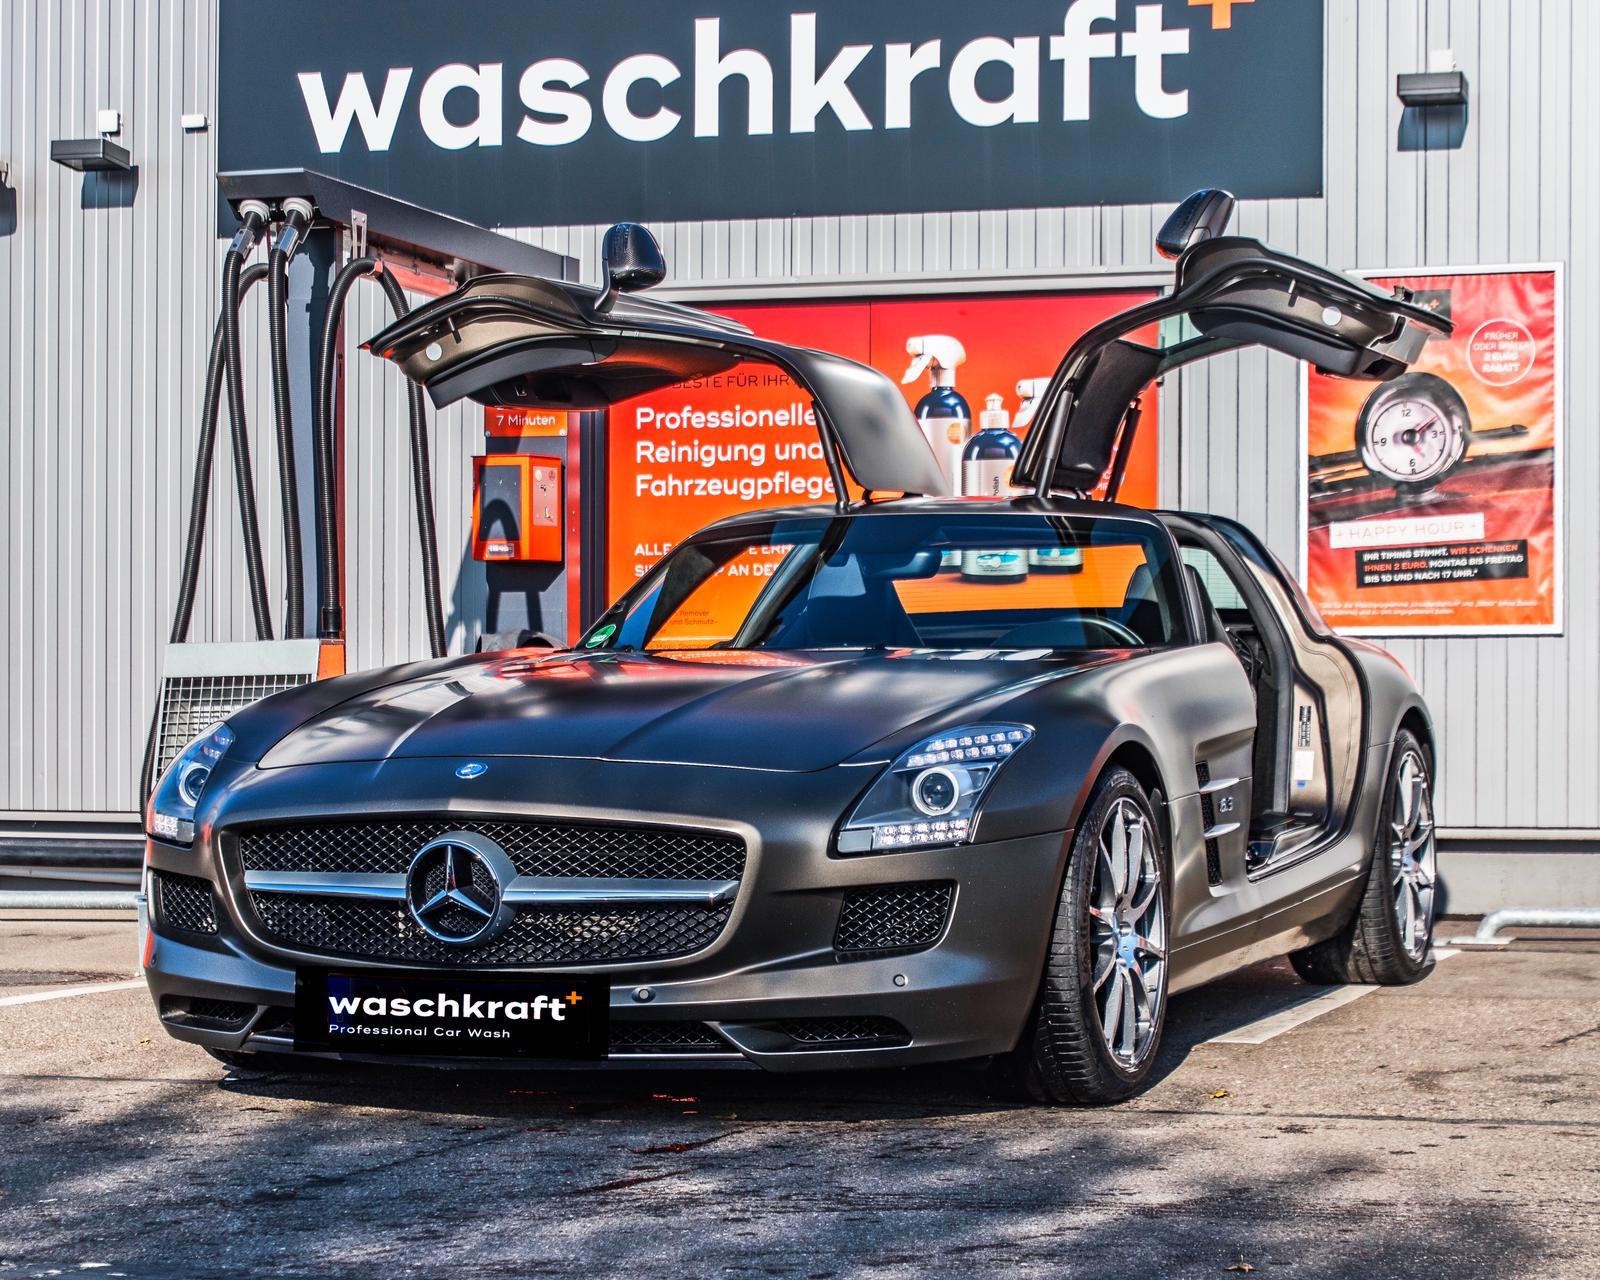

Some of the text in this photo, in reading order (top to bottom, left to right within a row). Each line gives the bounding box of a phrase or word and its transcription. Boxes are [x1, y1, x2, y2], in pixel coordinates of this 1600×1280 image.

[727, 373, 759, 388] FÜR
[763, 375, 790, 387] IHR
[636, 403, 816, 429] Professionelle
[1402, 408, 1411, 416] 12
[496, 415, 556, 426] 7 Minuten
[1432, 430, 1438, 438] 3
[1379, 438, 1387, 446] 9
[636, 440, 824, 467] Reinigung und
[1409, 458, 1415, 467] 6
[636, 472, 835, 500] Fahrzeugpflege
[1349, 521, 1465, 538] HAPPY HOUR
[1363, 544, 1518, 562] IHR TIMING STIMMT. WIR SCHENKEN
[728, 563, 749, 577] AN
[753, 563, 780, 577] DE
[1364, 554, 1523, 571] IHNEN 2 EURO. MONTAG BIS FREITAG
[1364, 574, 1379, 584] BIS
[1381, 574, 1393, 582] 10
[1394, 572, 1413, 582] UND
[1414, 571, 1440, 581] NACH
[1442, 570, 1451, 579] 17
[329, 1024, 511, 1039] Professional Car Wash
